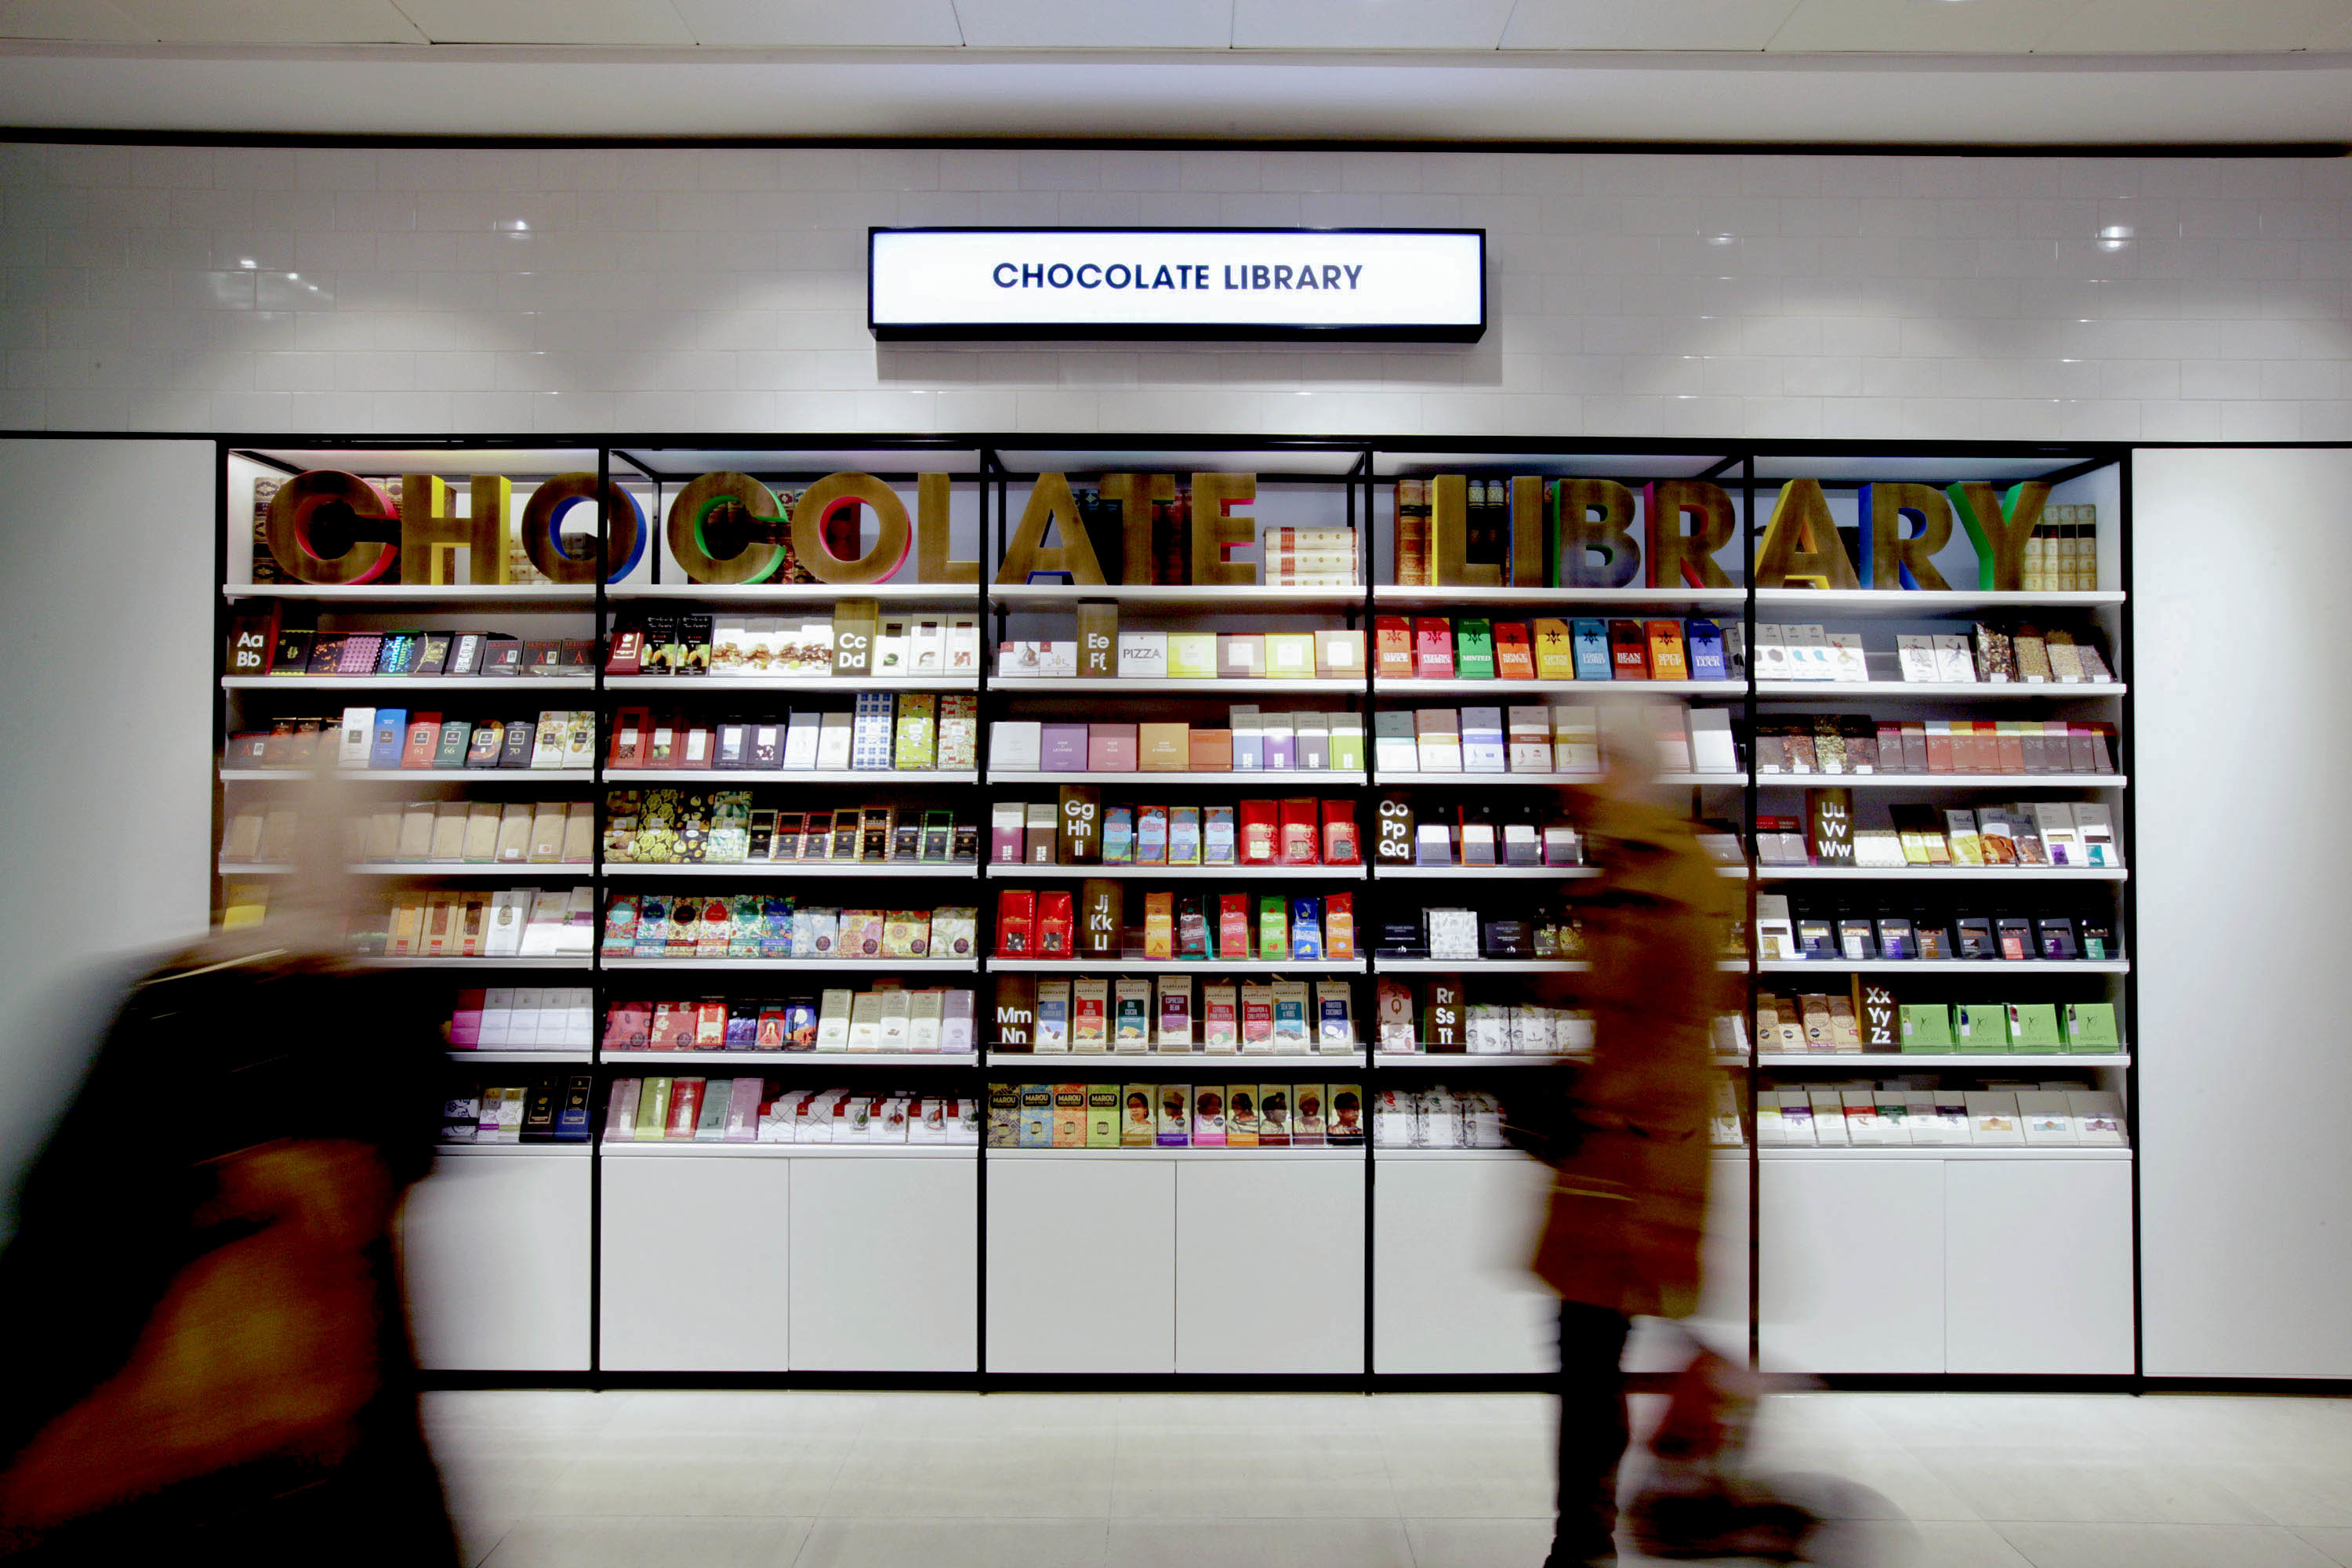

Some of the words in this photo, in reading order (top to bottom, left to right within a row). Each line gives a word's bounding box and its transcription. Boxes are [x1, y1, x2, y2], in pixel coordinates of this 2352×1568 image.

[993, 263, 1209, 289] CHOCOLATE
[1225, 265, 1363, 289] LIBRARY
[267, 469, 1257, 585] CHOCOLATE
[1432, 474, 2052, 590] LIBRARY
[238, 632, 263, 647] Aa
[840, 633, 866, 648] Cc
[1088, 633, 1109, 648] Ee
[237, 652, 260, 666] Bb
[840, 652, 865, 667] Dd
[1123, 648, 1161, 659] PIZZA
[1065, 800, 1094, 820] Gg
[1380, 801, 1408, 816] Oo
[1822, 802, 1846, 818] Uu
[1068, 820, 1091, 836] Hh
[1383, 820, 1406, 840] Pp
[1822, 822, 1846, 837] Vv
[1380, 840, 1409, 859] Qq
[1819, 841, 1851, 857] Ww
[1095, 895, 1108, 912] Jj
[1091, 914, 1112, 931] Kk
[1437, 988, 1454, 1004] Rr
[1867, 988, 1891, 1004] Xx
[1392, 999, 1402, 1014] Q
[998, 1007, 1031, 1023] Mm
[1436, 1007, 1454, 1024] Ss
[1868, 1007, 1890, 1026] Yy
[1002, 1028, 1026, 1044] Nn
[1439, 1028, 1453, 1044] Tt
[1871, 1027, 1891, 1044] Zz
